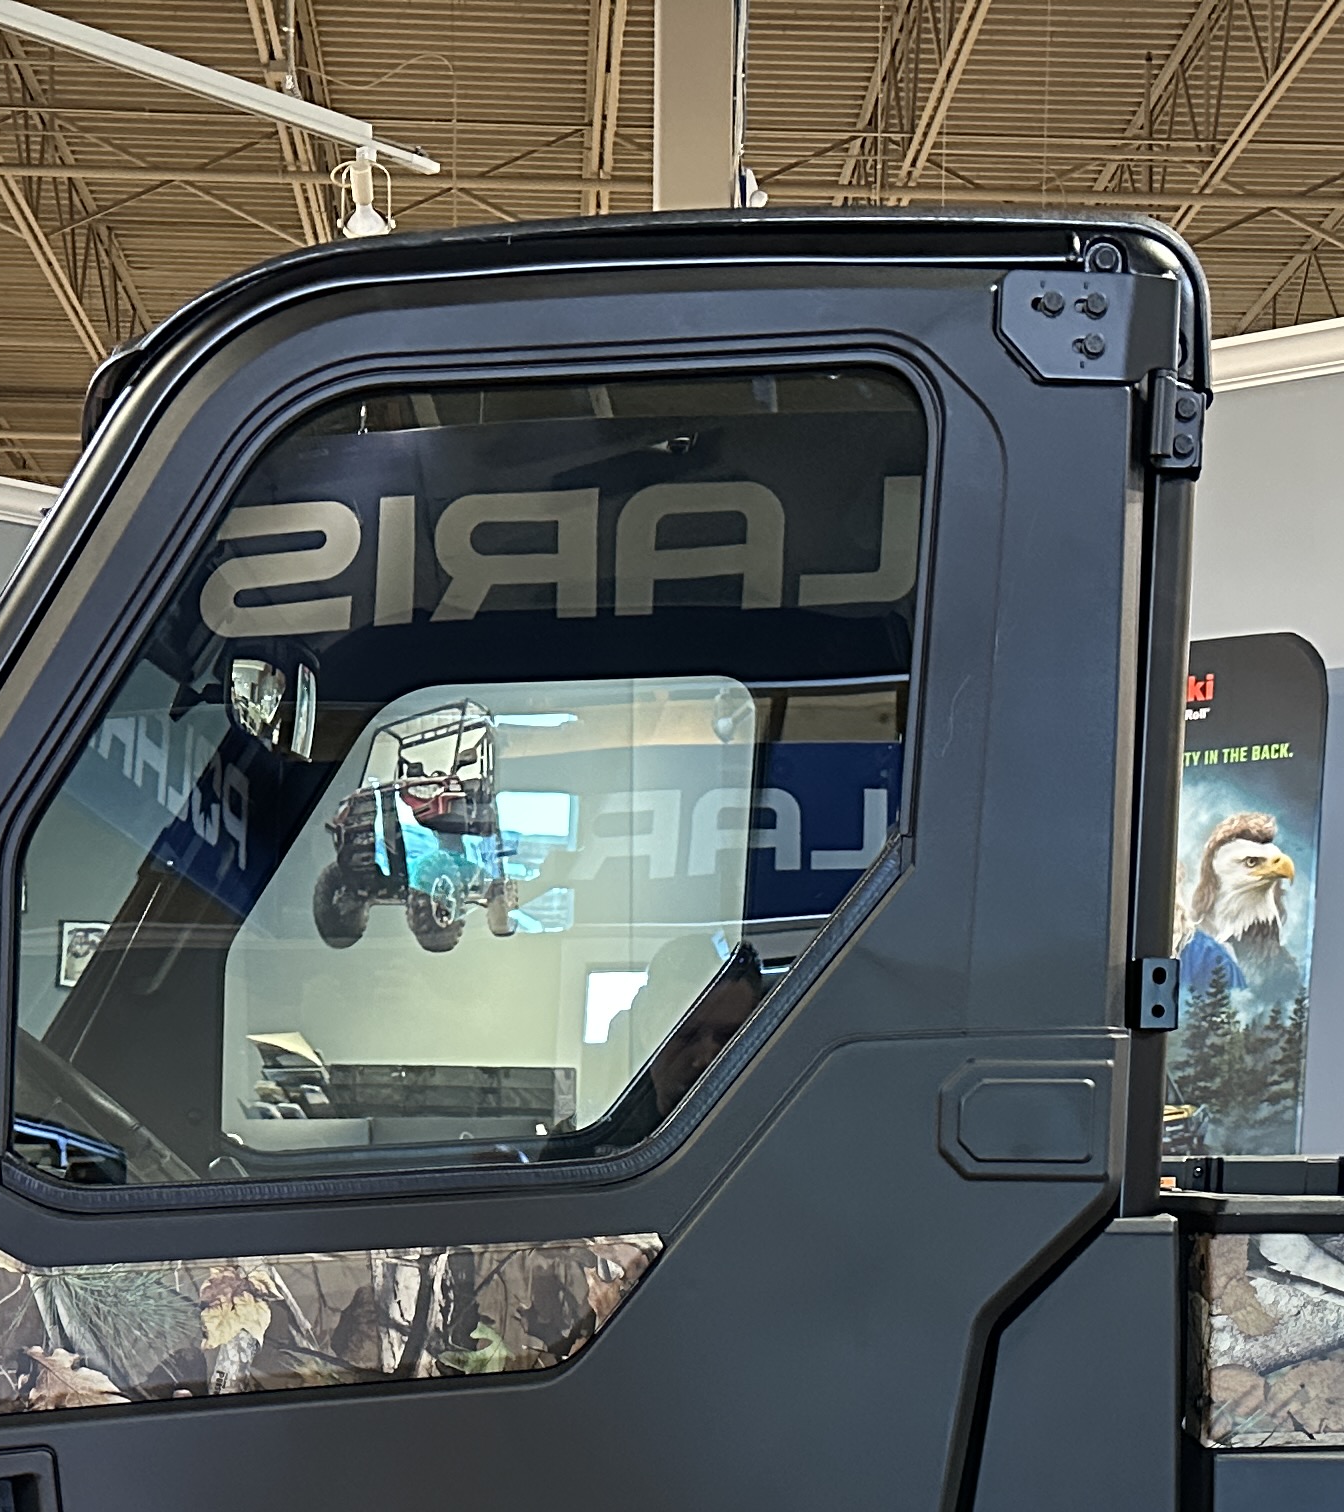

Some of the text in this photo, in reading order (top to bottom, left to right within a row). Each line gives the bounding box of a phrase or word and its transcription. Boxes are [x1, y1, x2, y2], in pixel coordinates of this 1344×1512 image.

[1204, 750, 1219, 765] IN
[1222, 746, 1248, 763] THE
[1251, 742, 1294, 762] BACK.
